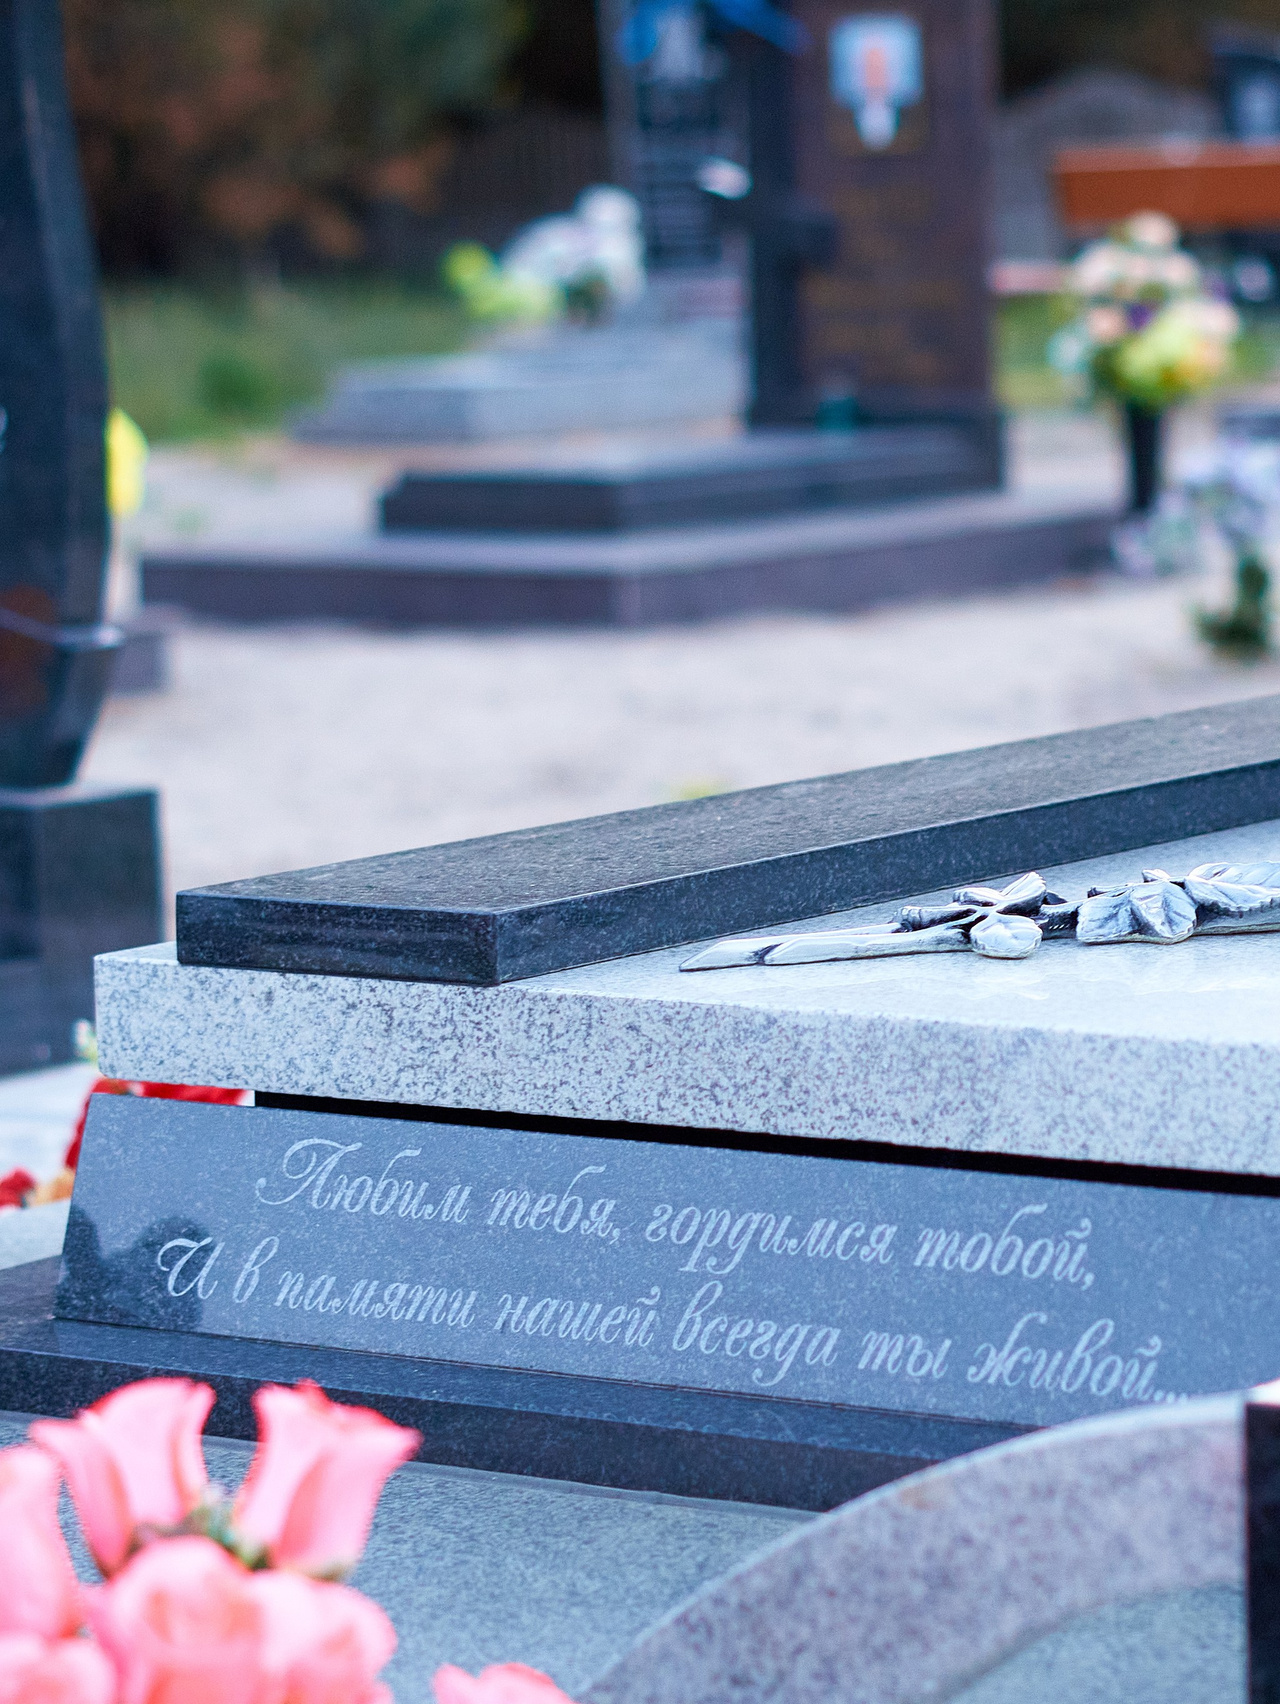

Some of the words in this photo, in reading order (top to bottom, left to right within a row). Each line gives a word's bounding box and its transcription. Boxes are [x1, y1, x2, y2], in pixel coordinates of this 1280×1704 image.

[254, 1137, 474, 1224] Любим
[489, 1164, 624, 1246] тебя,
[645, 1203, 897, 1276] гордимся
[912, 1202, 1096, 1289] тобой,
[156, 1236, 224, 1298] И
[231, 1235, 280, 1302] в
[274, 1267, 477, 1330] памяти
[494, 1285, 662, 1347] нашей
[672, 1280, 840, 1388] всегда
[856, 1328, 953, 1380] ты
